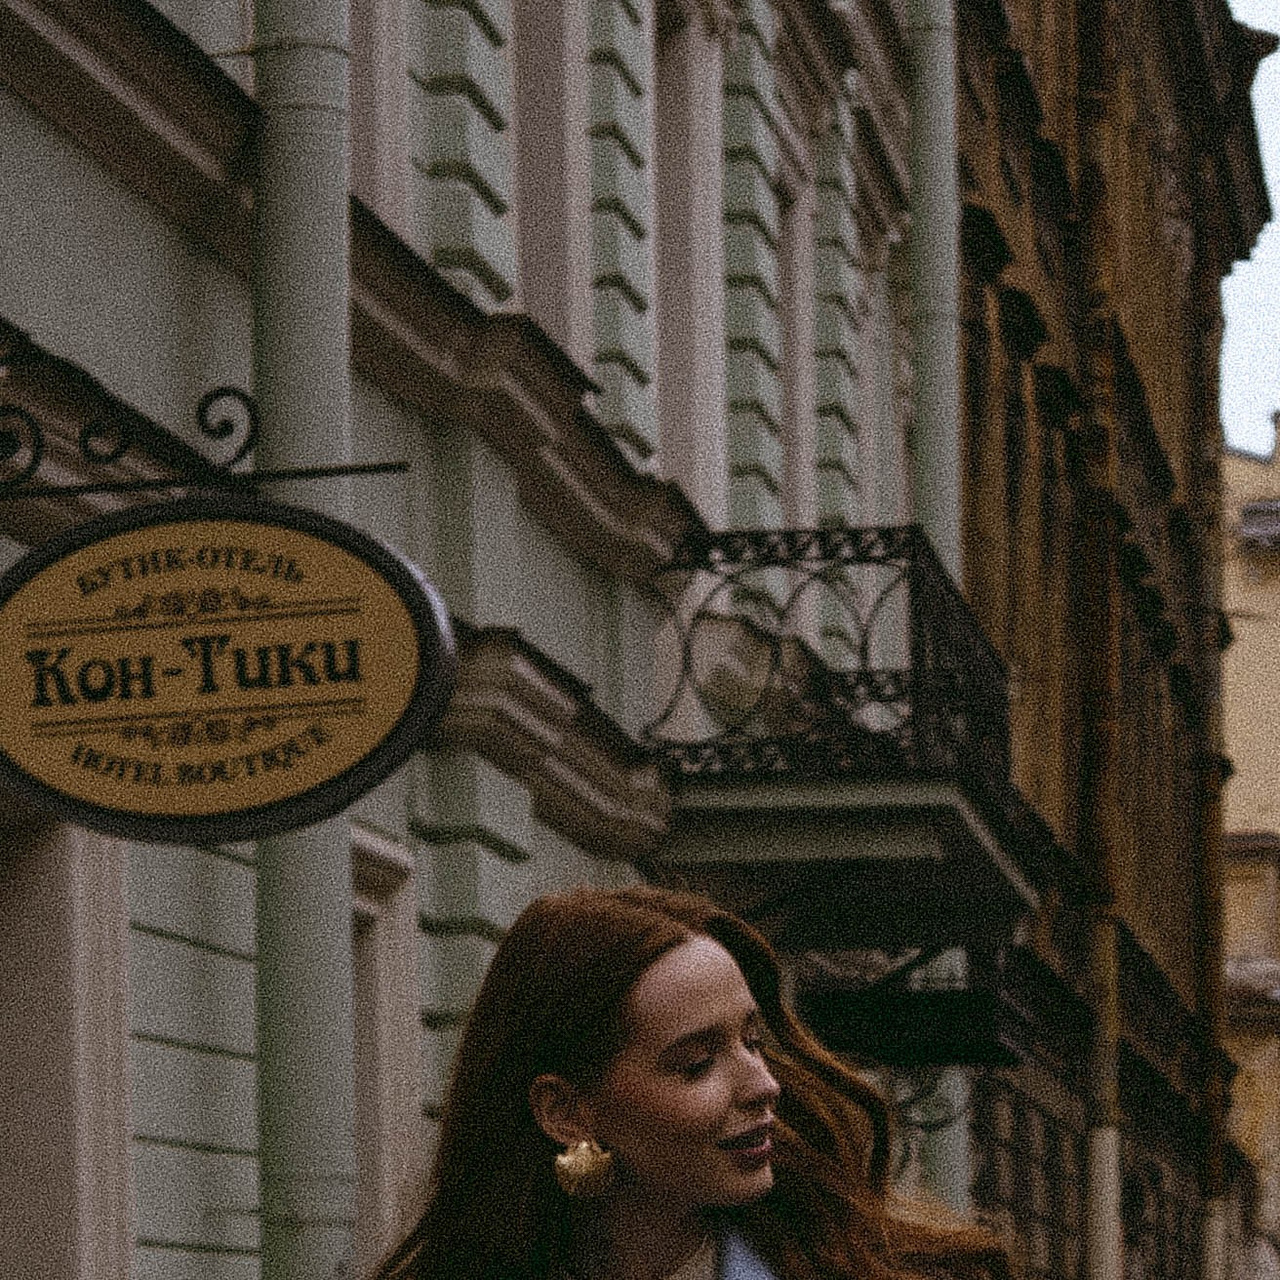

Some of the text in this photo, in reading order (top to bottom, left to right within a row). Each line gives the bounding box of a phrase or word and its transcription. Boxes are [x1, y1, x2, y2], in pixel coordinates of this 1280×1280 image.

[76, 546, 305, 596] БУТИК-ОТЕЛЬ
[25, 634, 362, 706] Кон-Тики
[70, 742, 164, 787] HOTEL
